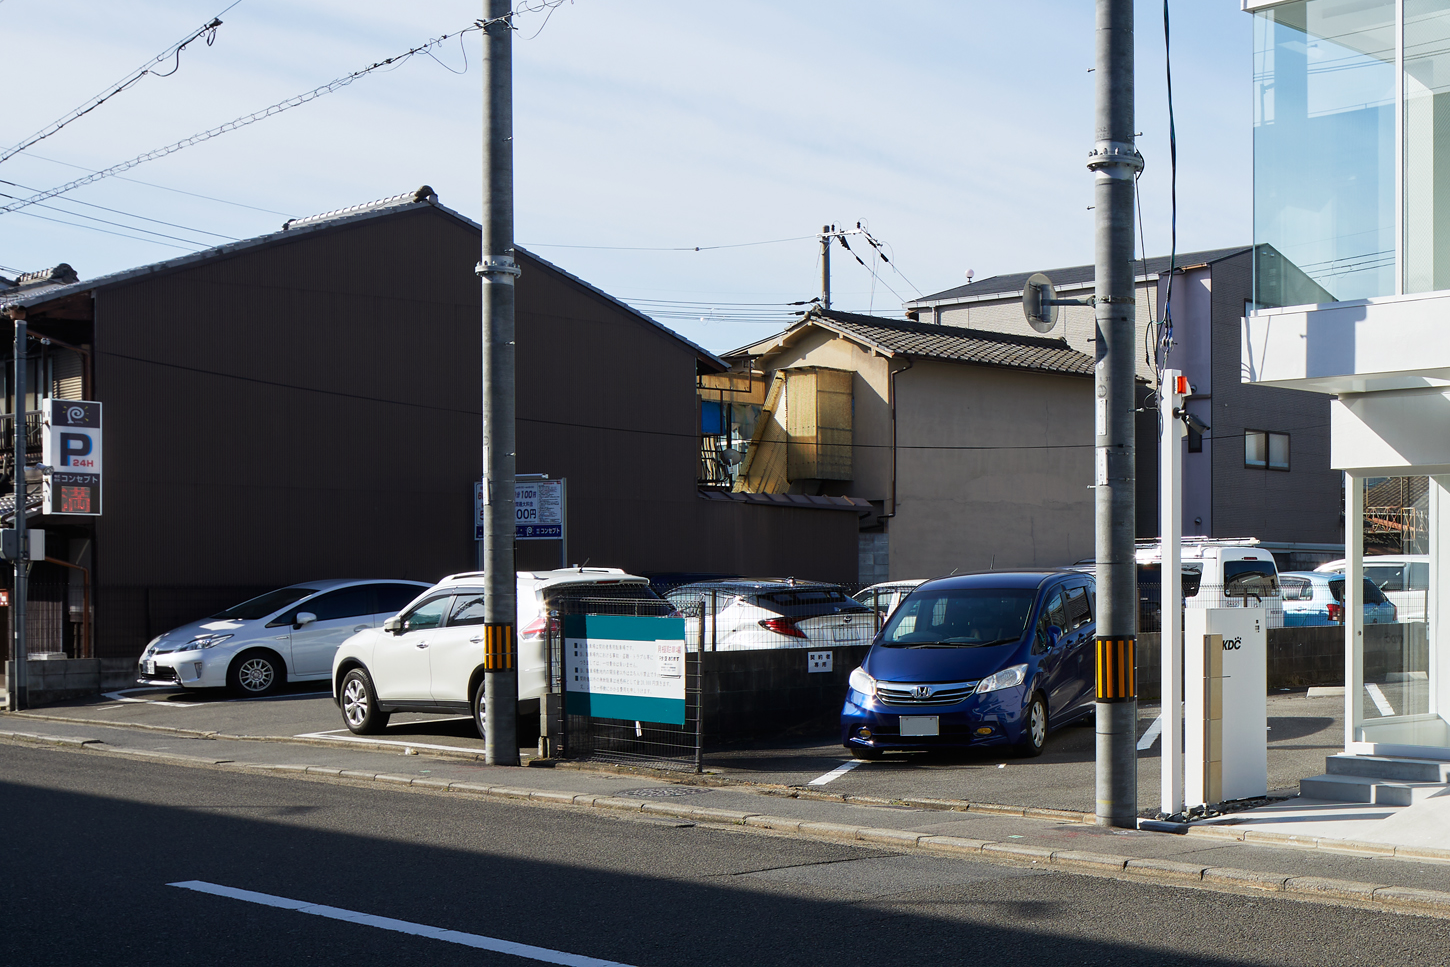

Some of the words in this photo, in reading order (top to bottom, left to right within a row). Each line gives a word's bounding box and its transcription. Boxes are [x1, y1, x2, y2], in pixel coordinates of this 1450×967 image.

[60, 432, 93, 467] P
[72, 459, 94, 468] 24H
[61, 475, 98, 484] コンセプト
[1222, 638, 1242, 651] KDC
